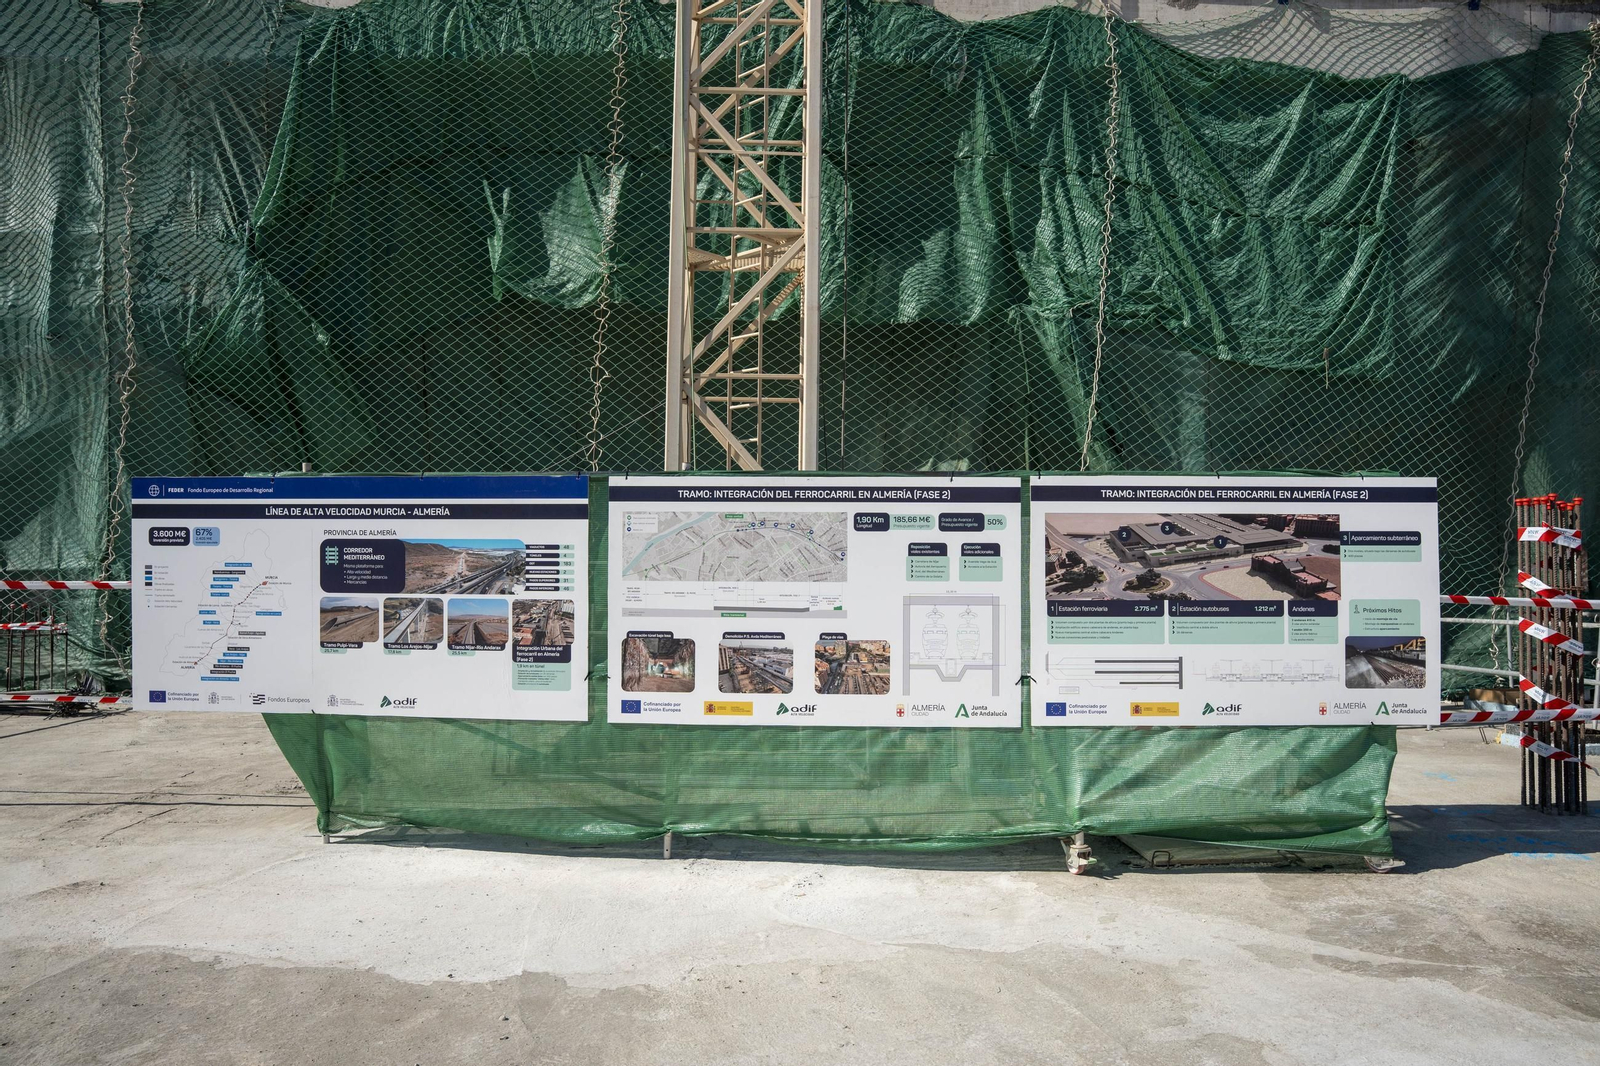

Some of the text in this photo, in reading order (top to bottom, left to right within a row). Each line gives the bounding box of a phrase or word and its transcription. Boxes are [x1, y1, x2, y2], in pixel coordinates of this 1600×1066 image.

[678, 489, 950, 499] TRAMO: INTEGRACIÓN DEL FERROCARRIL EN ALMERÍA (FASE 2)
[1101, 488, 1368, 500] TRAMO: INTEGRACIÓN DEL FERROCARRIL EN ALMERÍA (FASE 2)
[265, 506, 289, 516] LÍNEA
[290, 508, 301, 516] DE
[302, 508, 324, 516] ALTA
[325, 508, 372, 516] VELOCIDAD
[373, 508, 406, 516] MURCIA
[412, 506, 450, 516] ALMERÍA
[911, 703, 946, 712] ALMERÍA
[1216, 704, 1242, 712] adif
